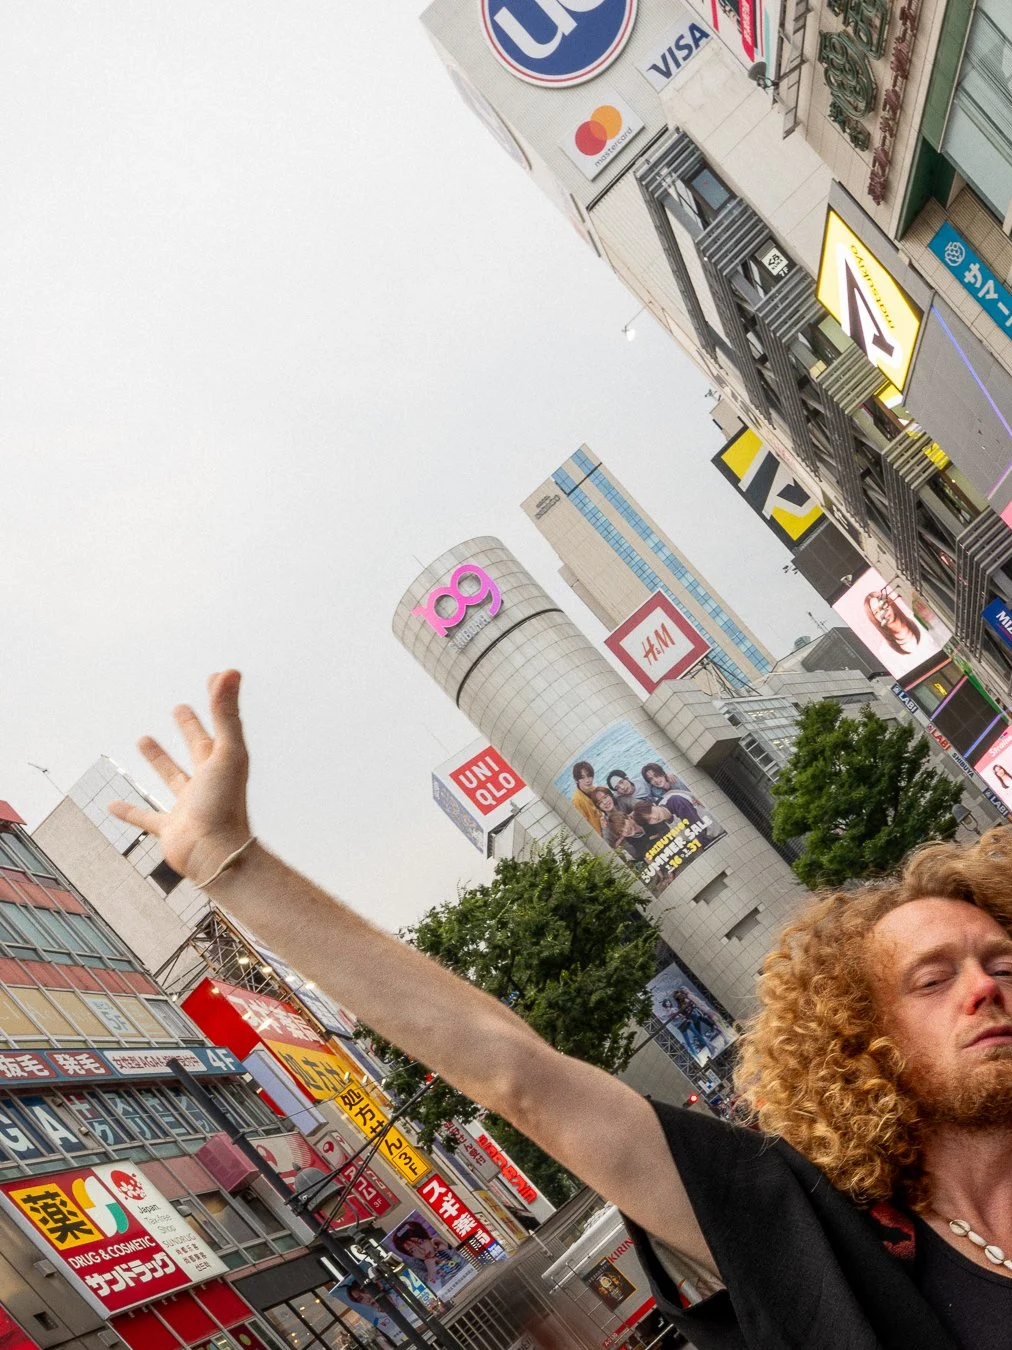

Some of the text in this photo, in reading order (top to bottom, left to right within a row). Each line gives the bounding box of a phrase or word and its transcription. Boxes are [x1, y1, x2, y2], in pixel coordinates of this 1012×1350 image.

[648, 22, 710, 80] VISA
[595, 126, 634, 168] mastercard
[778, 267, 790, 278] 7F
[849, 244, 896, 330] matsukiyo
[411, 564, 503, 638] 109
[641, 621, 676, 666] H&M
[898, 690, 918, 713] LABI
[930, 728, 952, 751] LABI
[458, 755, 500, 789] UNI
[952, 753, 974, 778] SHIBUYA
[475, 771, 516, 808] QLO
[990, 797, 1009, 817] LABI
[641, 837, 687, 885] SUMMER
[53, 1053, 105, 1076] 発毛
[206, 1048, 236, 1072] 4F
[398, 1150, 421, 1176] 3F
[21, 1190, 94, 1245] 薬
[156, 1223, 178, 1235] Shop
[67, 1234, 158, 1270] DRUG & COSMETIC
[162, 1232, 198, 1250] SUNDRUG
[607, 1236, 635, 1265] KIRIN
[83, 1250, 178, 1298] サンドラッグ
